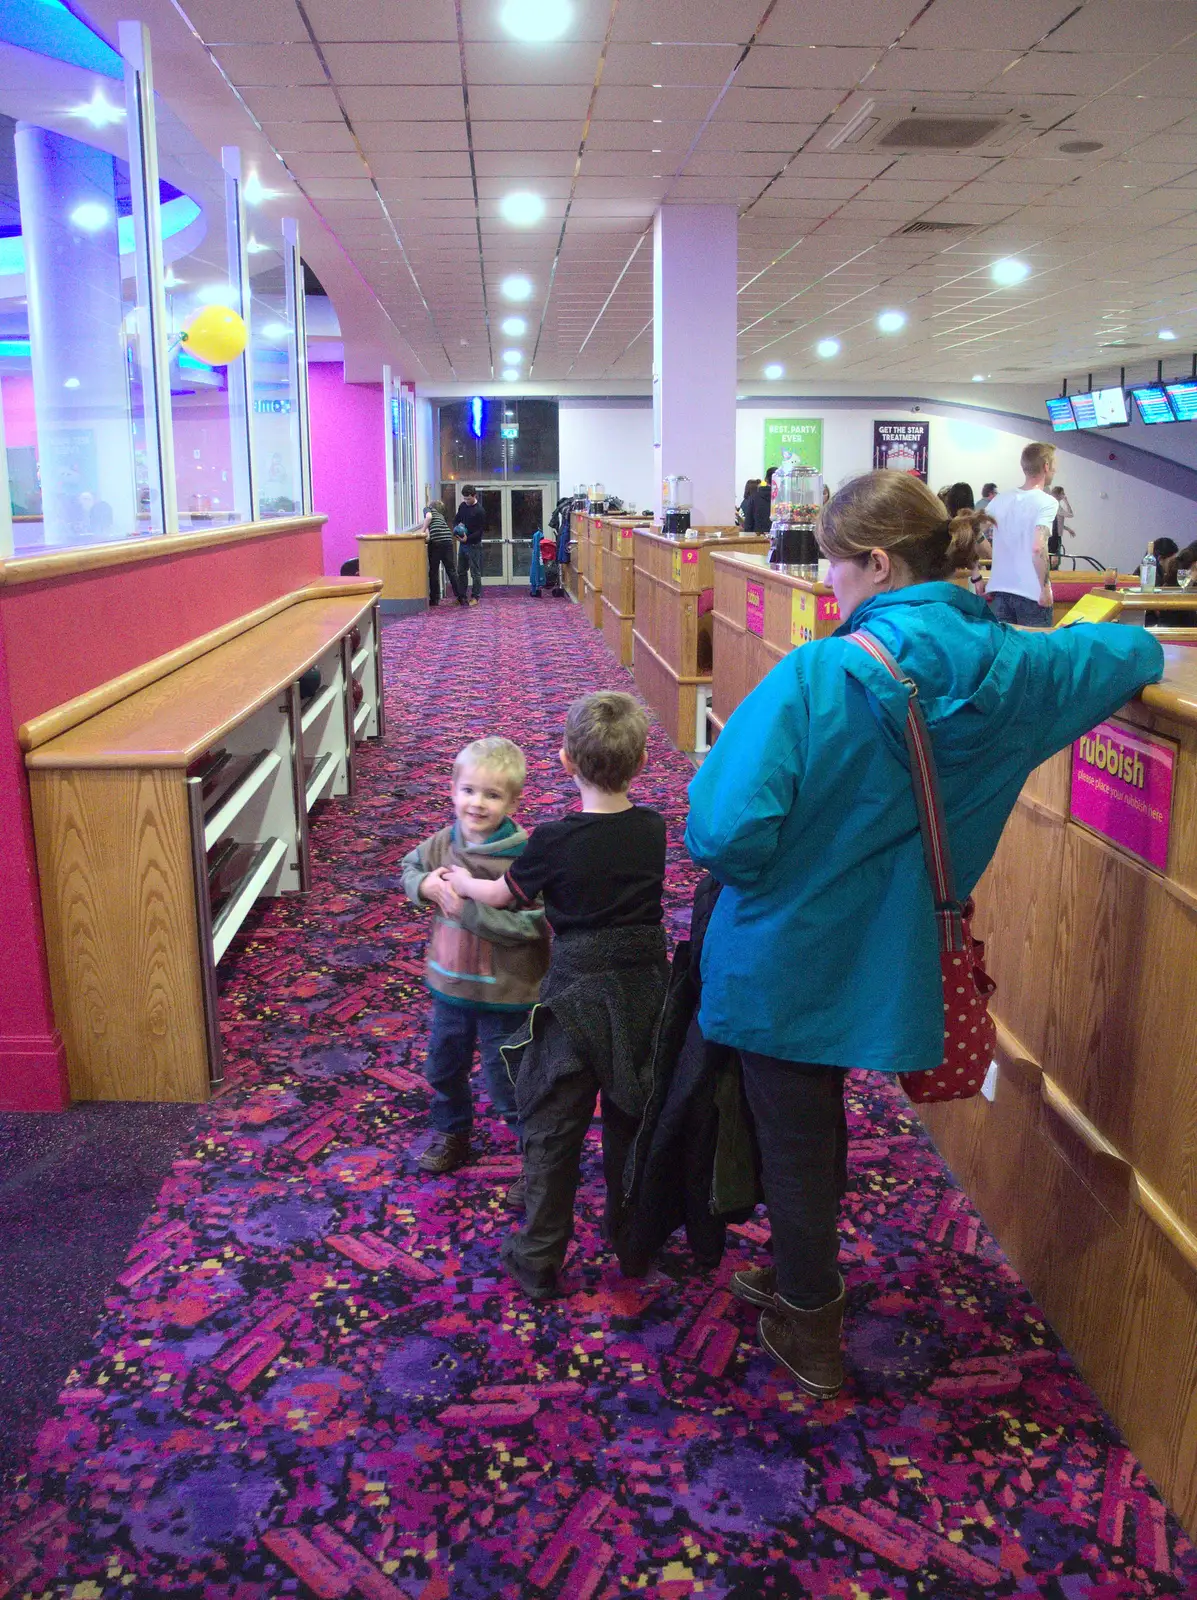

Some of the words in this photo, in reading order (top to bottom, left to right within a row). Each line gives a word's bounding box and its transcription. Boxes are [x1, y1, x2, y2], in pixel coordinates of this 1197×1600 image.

[878, 426, 892, 434] GET
[893, 426, 906, 434] THE
[907, 426, 924, 434] STAR
[687, 552, 693, 560] 9
[824, 601, 838, 615] 11
[1079, 733, 1144, 788] rubbish
[1077, 770, 1095, 786] please
[1094, 778, 1110, 794] place
[1110, 787, 1124, 801] your
[1124, 794, 1147, 813] rubbish
[1149, 804, 1163, 822] here
